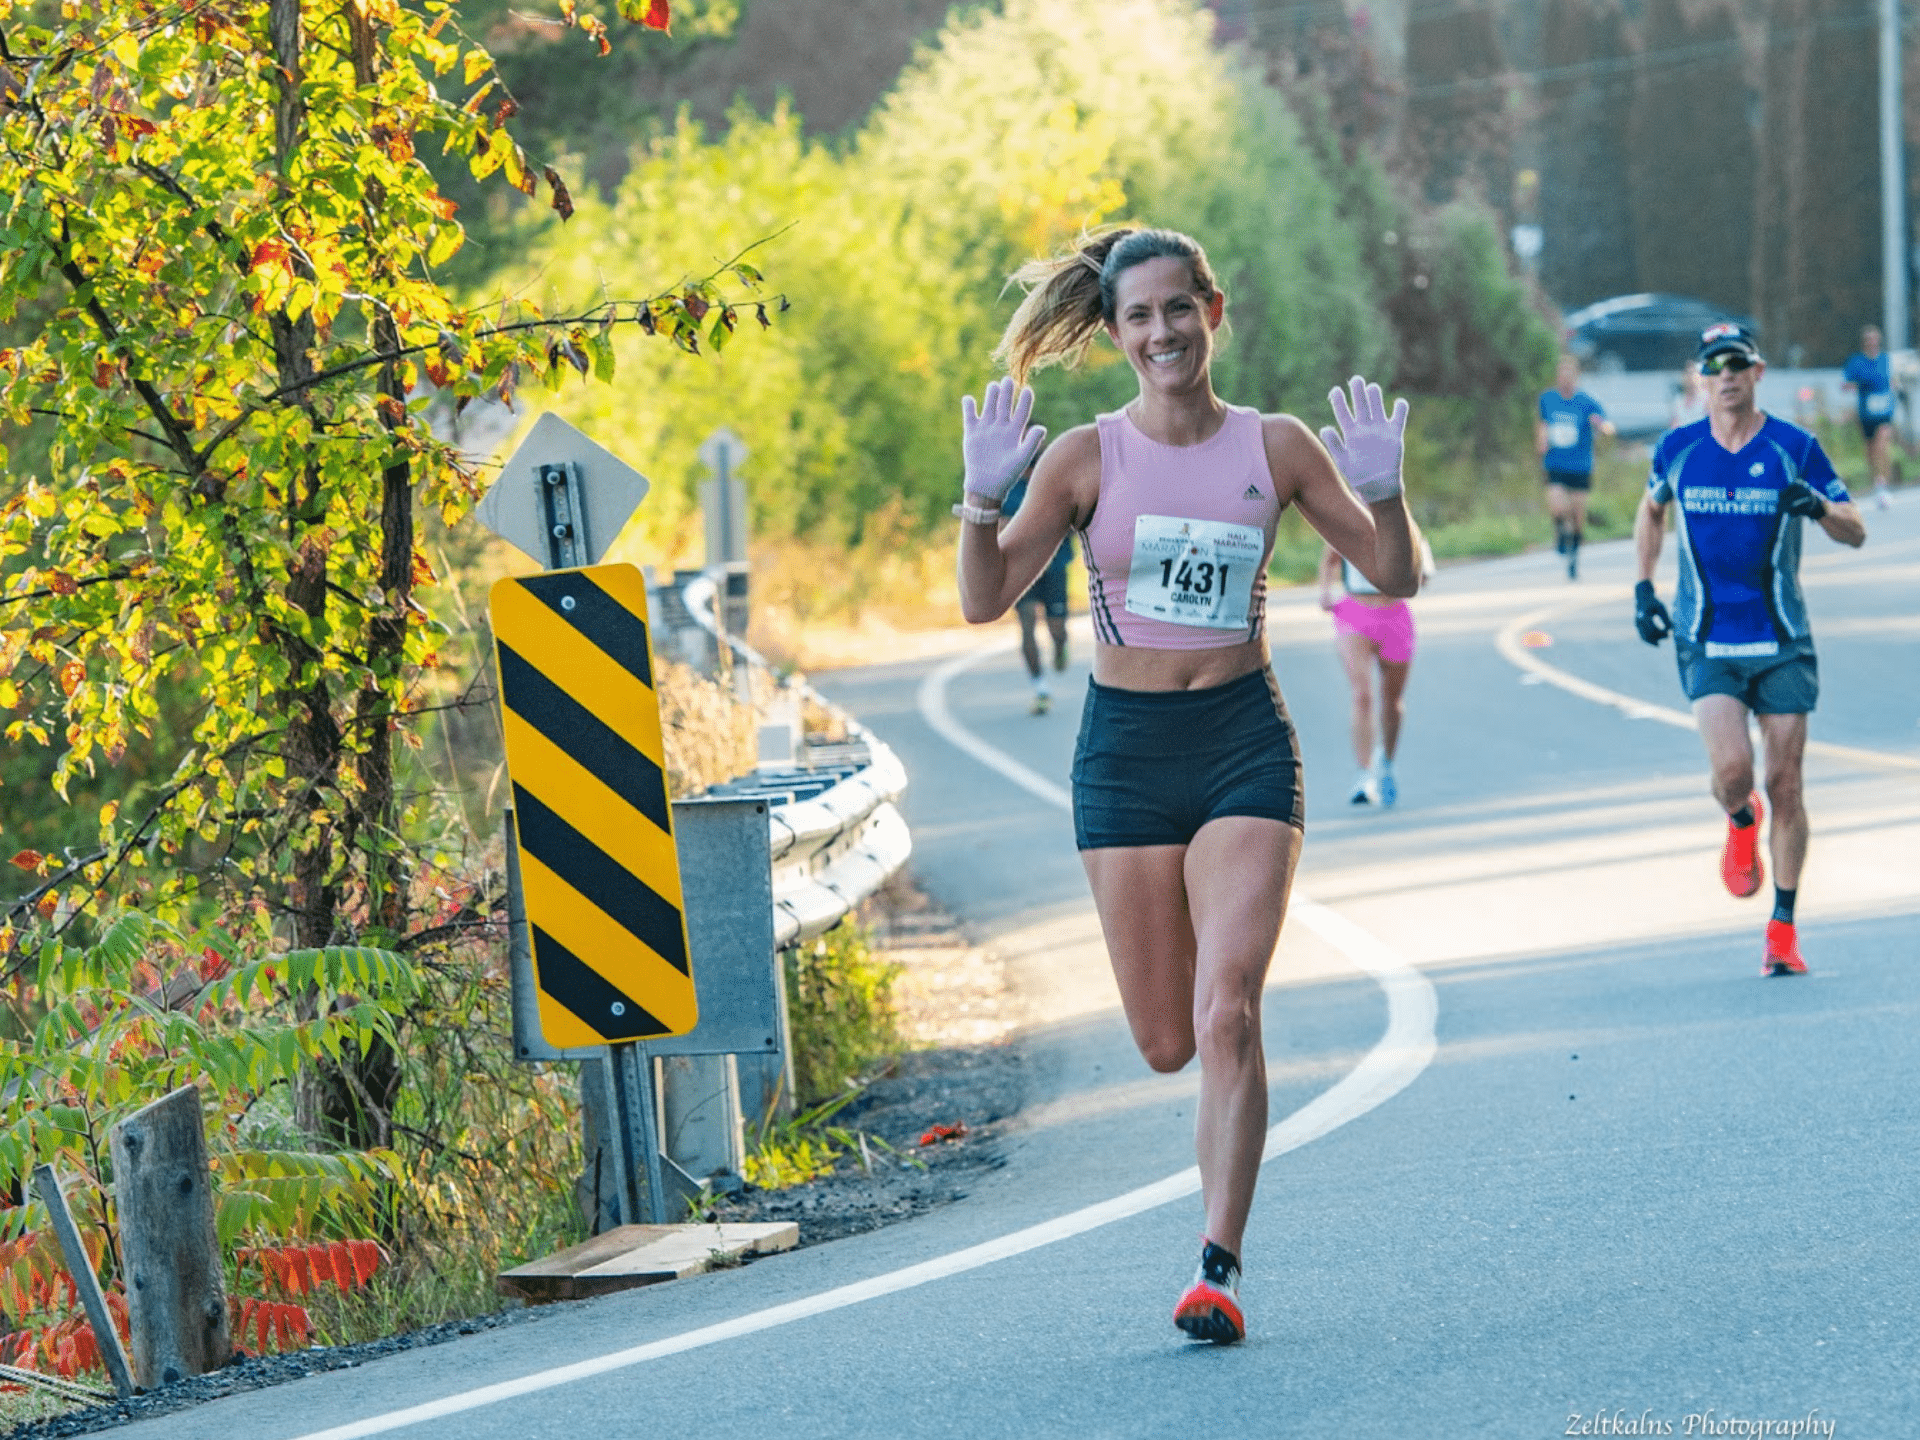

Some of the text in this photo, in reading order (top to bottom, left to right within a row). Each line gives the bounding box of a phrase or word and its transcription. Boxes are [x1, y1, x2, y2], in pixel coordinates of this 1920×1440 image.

[1227, 532, 1248, 541] HALF
[1213, 538, 1259, 551] MARATHON
[1160, 558, 1229, 596] 1431
[1170, 591, 1212, 607] CAROLYN
